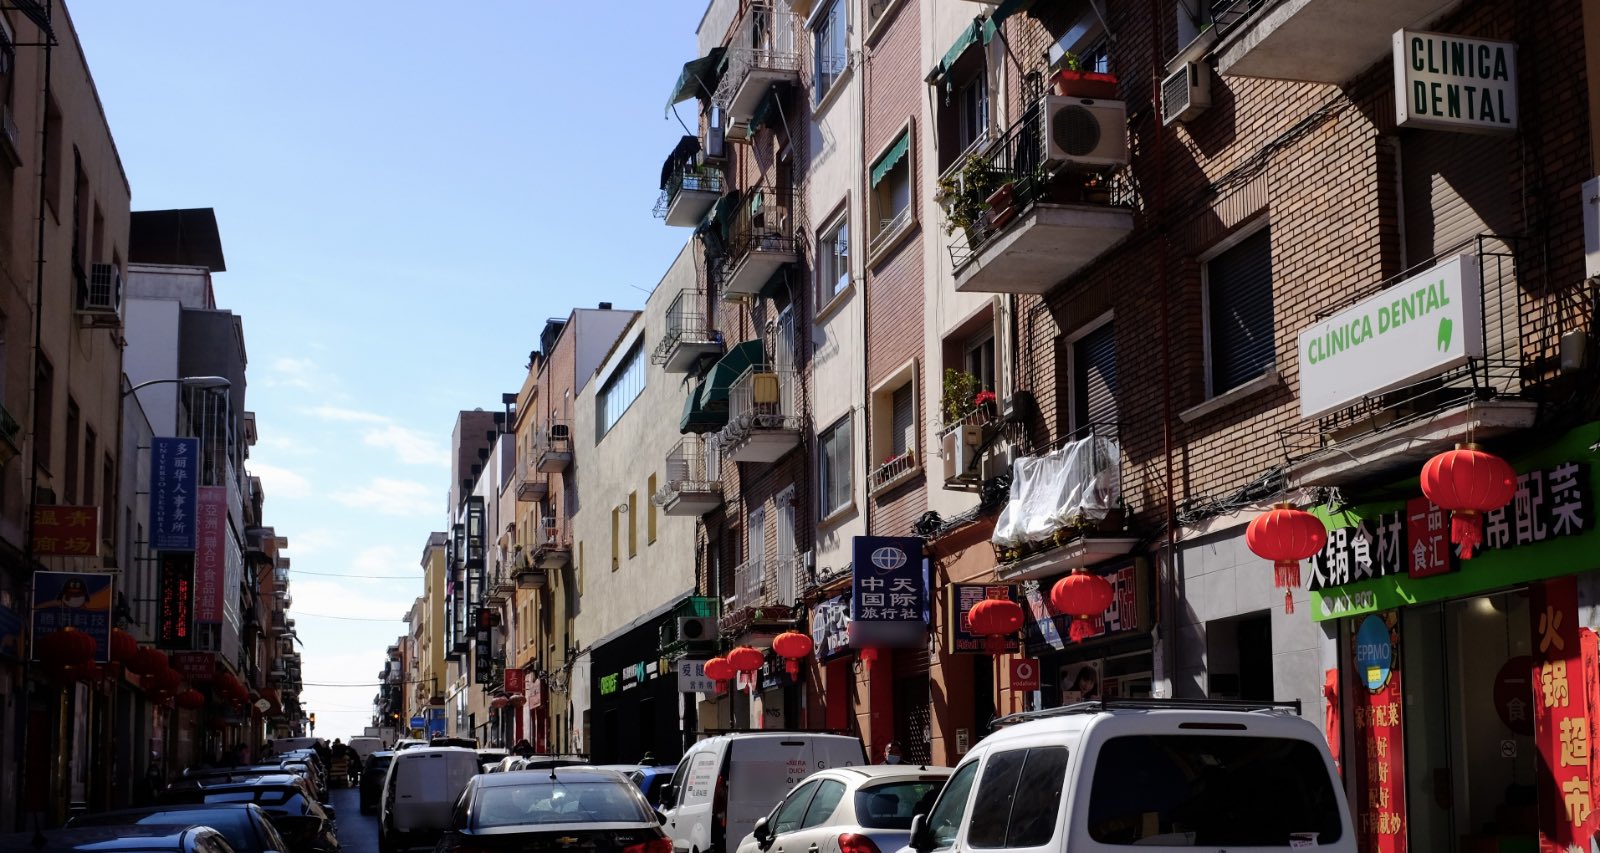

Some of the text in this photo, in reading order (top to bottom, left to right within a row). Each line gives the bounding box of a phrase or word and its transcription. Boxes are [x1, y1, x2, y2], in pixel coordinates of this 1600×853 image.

[1411, 37, 1508, 82] CLINICA
[1413, 80, 1511, 124] DENTAL
[1308, 279, 1450, 365] CLÍNICA DENTAL
[157, 442, 168, 487] UNIVERSO
[170, 442, 188, 534] 多丽华人事务所
[1411, 503, 1443, 531] 一品
[1455, 462, 1584, 557] 常配菜
[33, 536, 91, 553] 商场
[1306, 510, 1401, 591] 火锅食材
[1412, 535, 1446, 572] 食汇
[861, 576, 917, 592] 中天
[861, 593, 918, 607] 国际
[1355, 590, 1373, 608] POT
[861, 607, 918, 620] 旅行社
[1357, 642, 1390, 661] EPPMO
[1013, 679, 1037, 687] vodafone
[1355, 703, 1399, 728] 家常配菜
